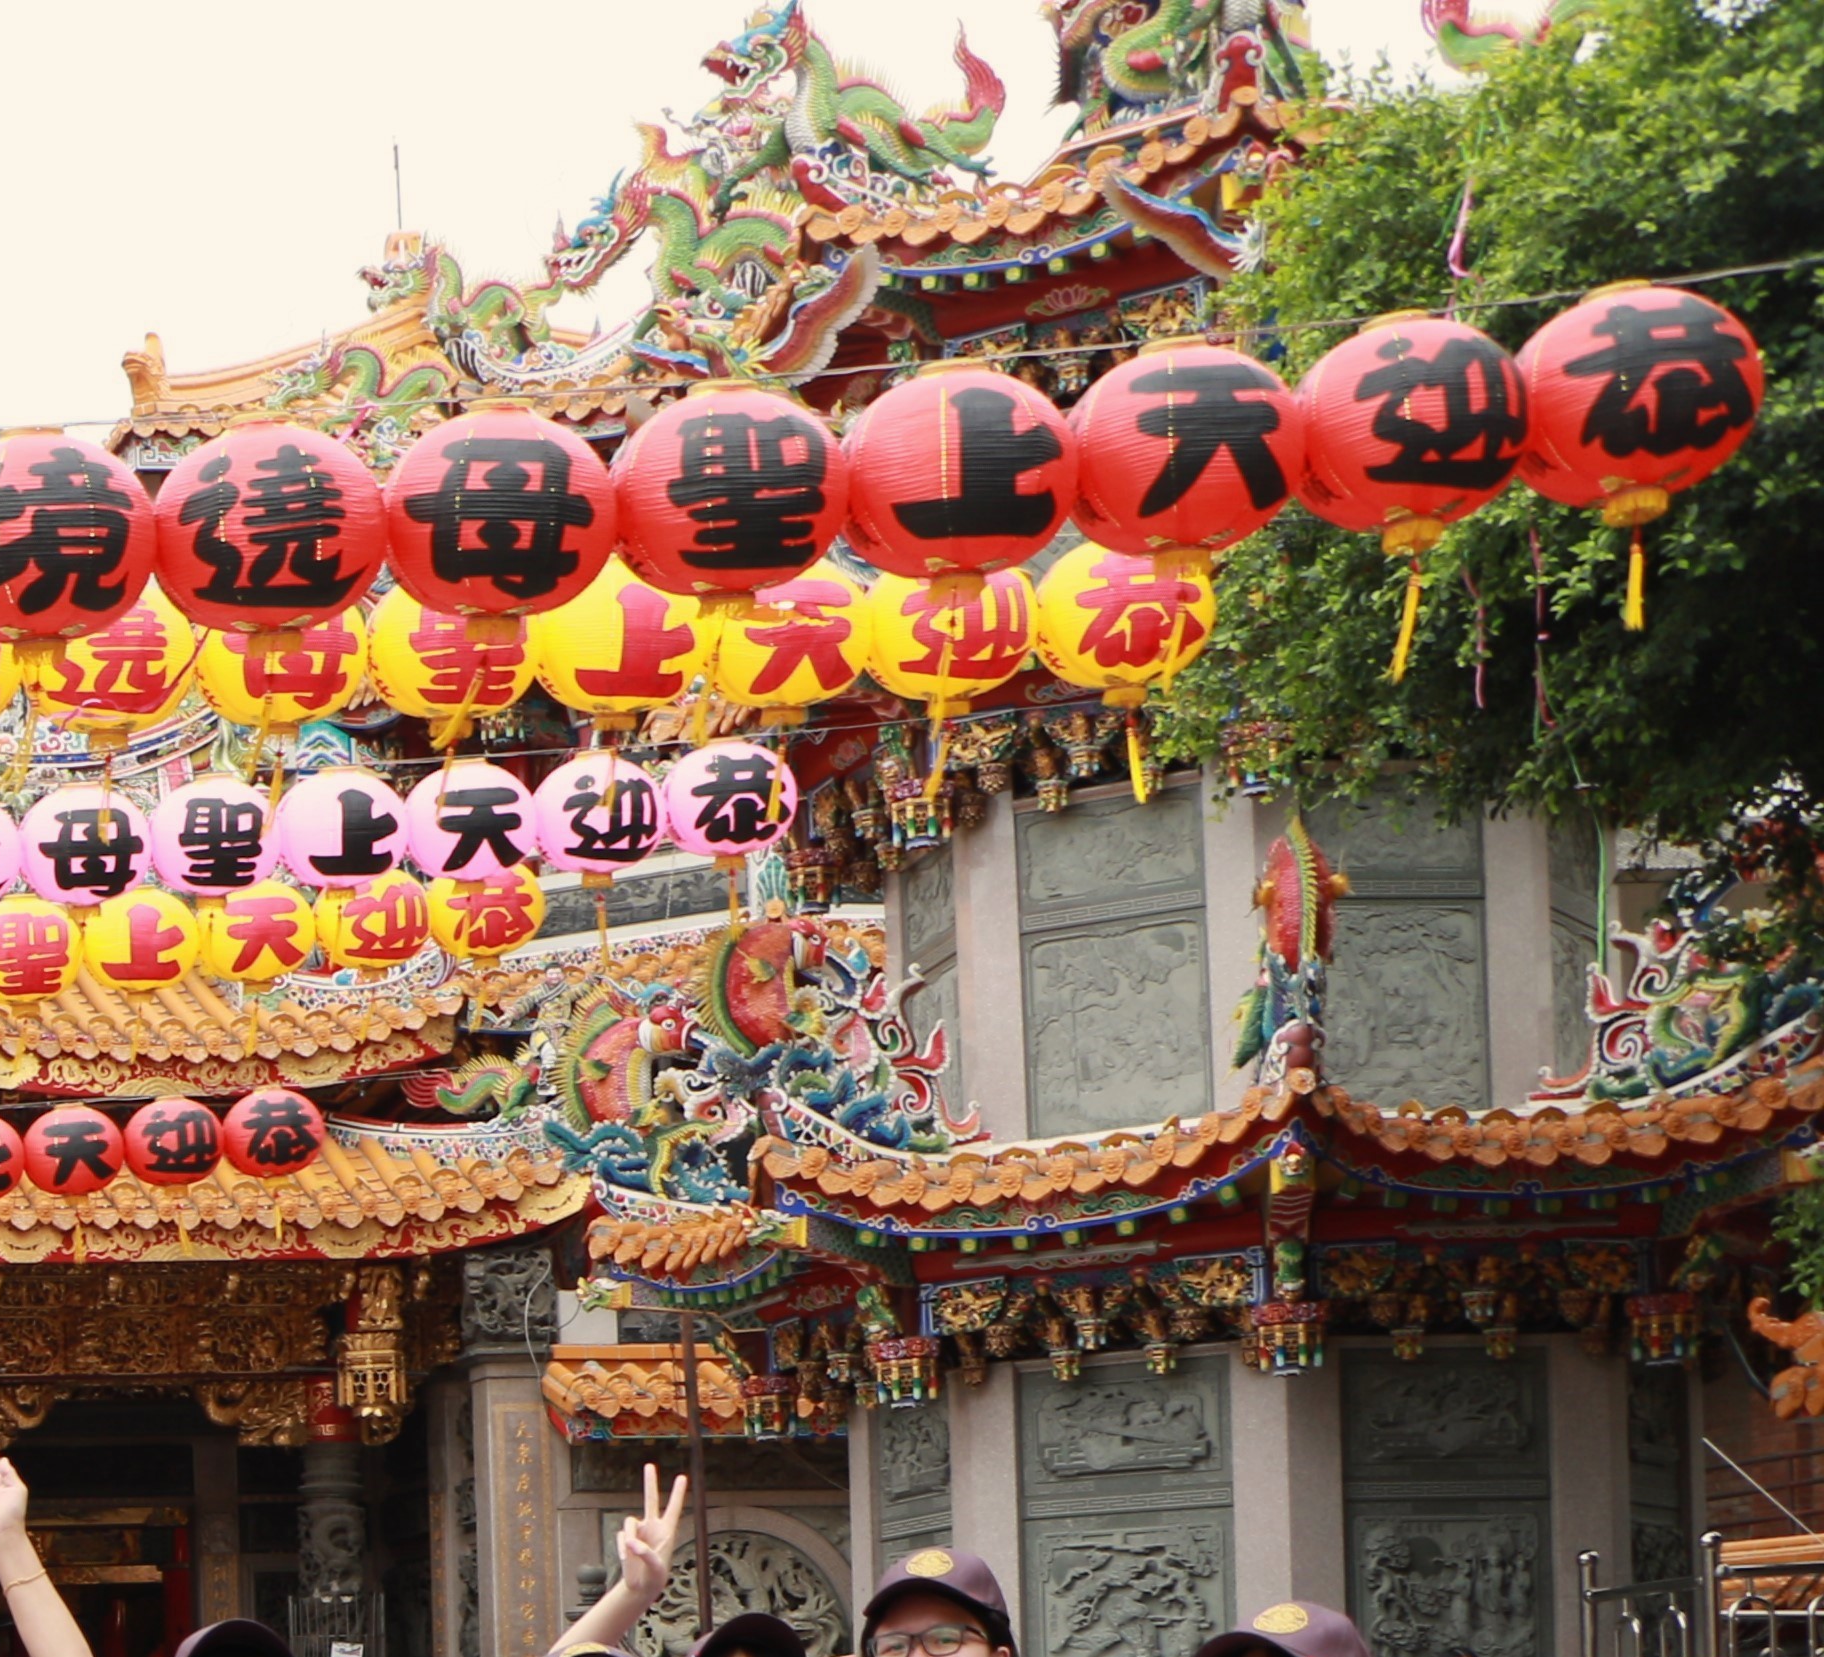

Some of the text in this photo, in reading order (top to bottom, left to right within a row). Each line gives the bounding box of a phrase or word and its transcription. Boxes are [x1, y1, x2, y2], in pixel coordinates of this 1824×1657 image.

[1130, 364, 1287, 517] 天
[1356, 335, 1528, 489] 迎
[1563, 297, 1752, 457] 恭
[178, 445, 372, 608] 遶
[403, 437, 593, 599] 母
[667, 412, 826, 569] 聖
[893, 387, 1062, 539] 上
[39, 808, 144, 897] 母
[179, 797, 264, 887] 聖
[308, 789, 398, 877] 上
[440, 787, 525, 871] 天
[563, 775, 654, 862] 迎
[693, 754, 790, 843] 恭
